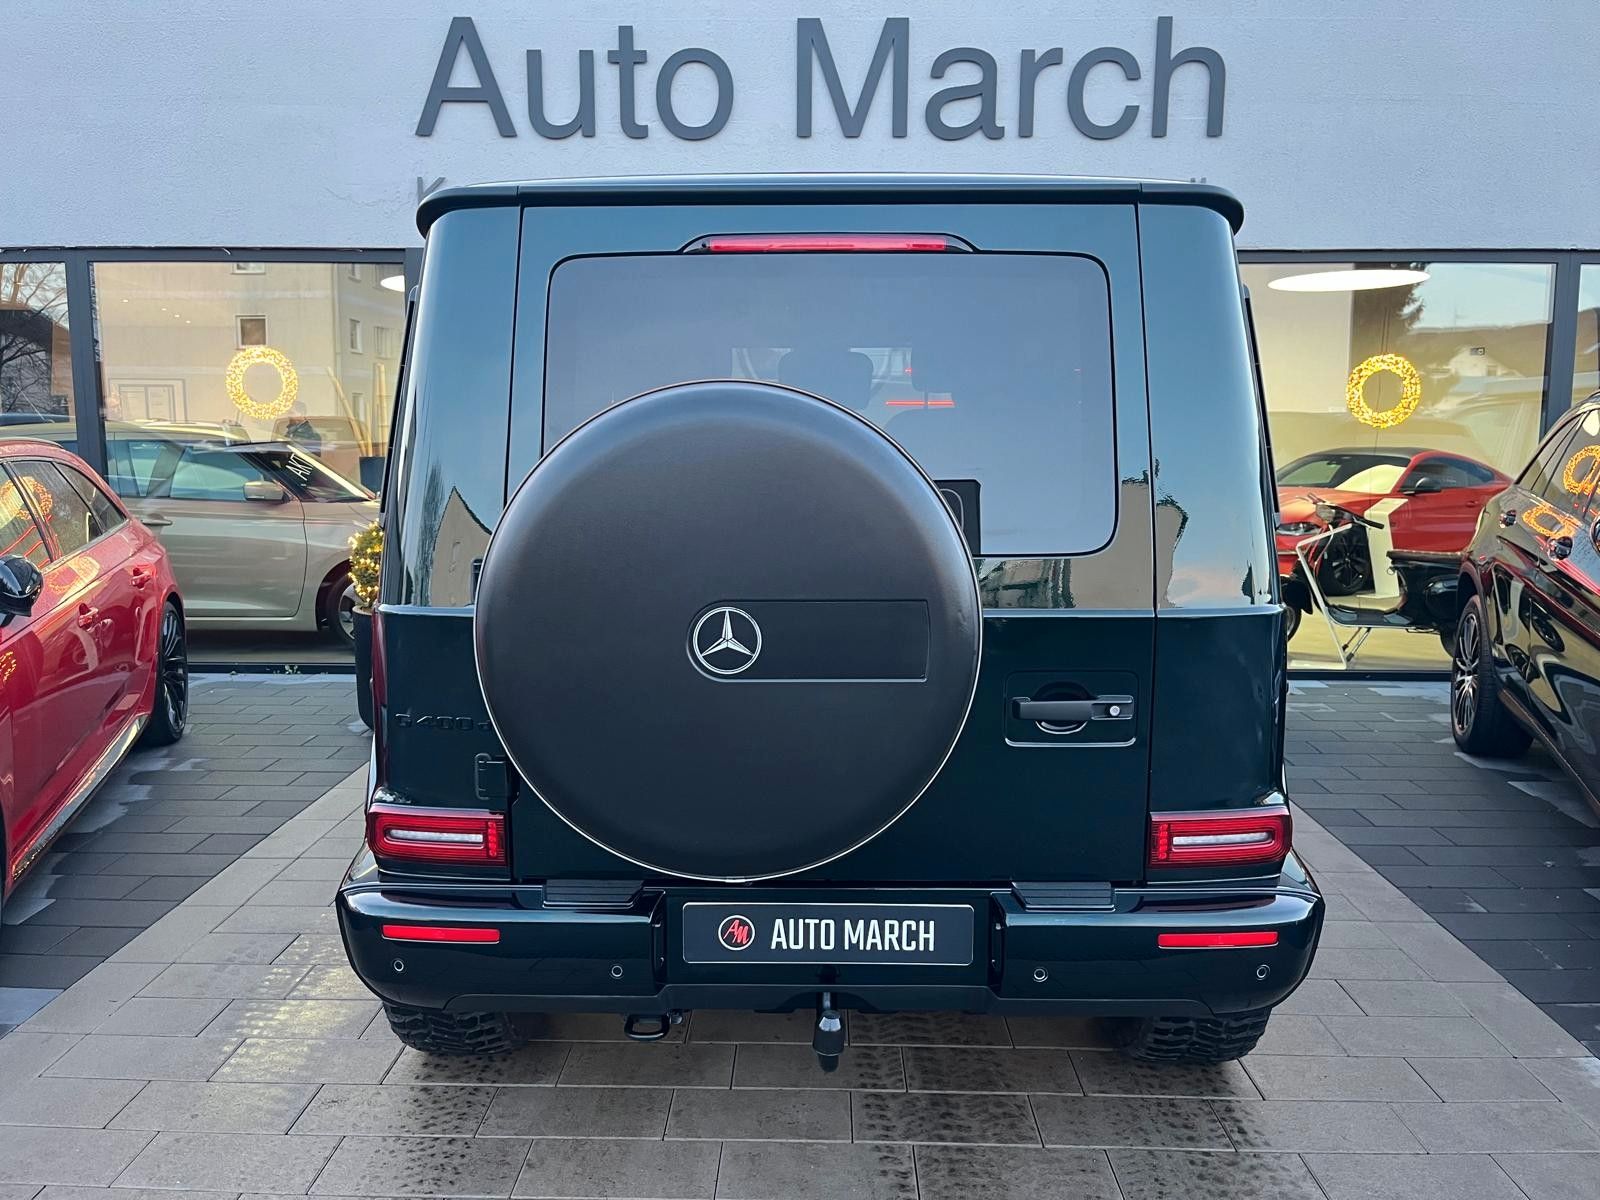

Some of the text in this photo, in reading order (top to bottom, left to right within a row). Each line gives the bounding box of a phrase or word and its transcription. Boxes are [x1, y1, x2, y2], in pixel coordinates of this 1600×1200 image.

[415, 16, 1226, 141] Auto March
[770, 918, 836, 950] AUTO
[844, 919, 936, 952] MARCH
